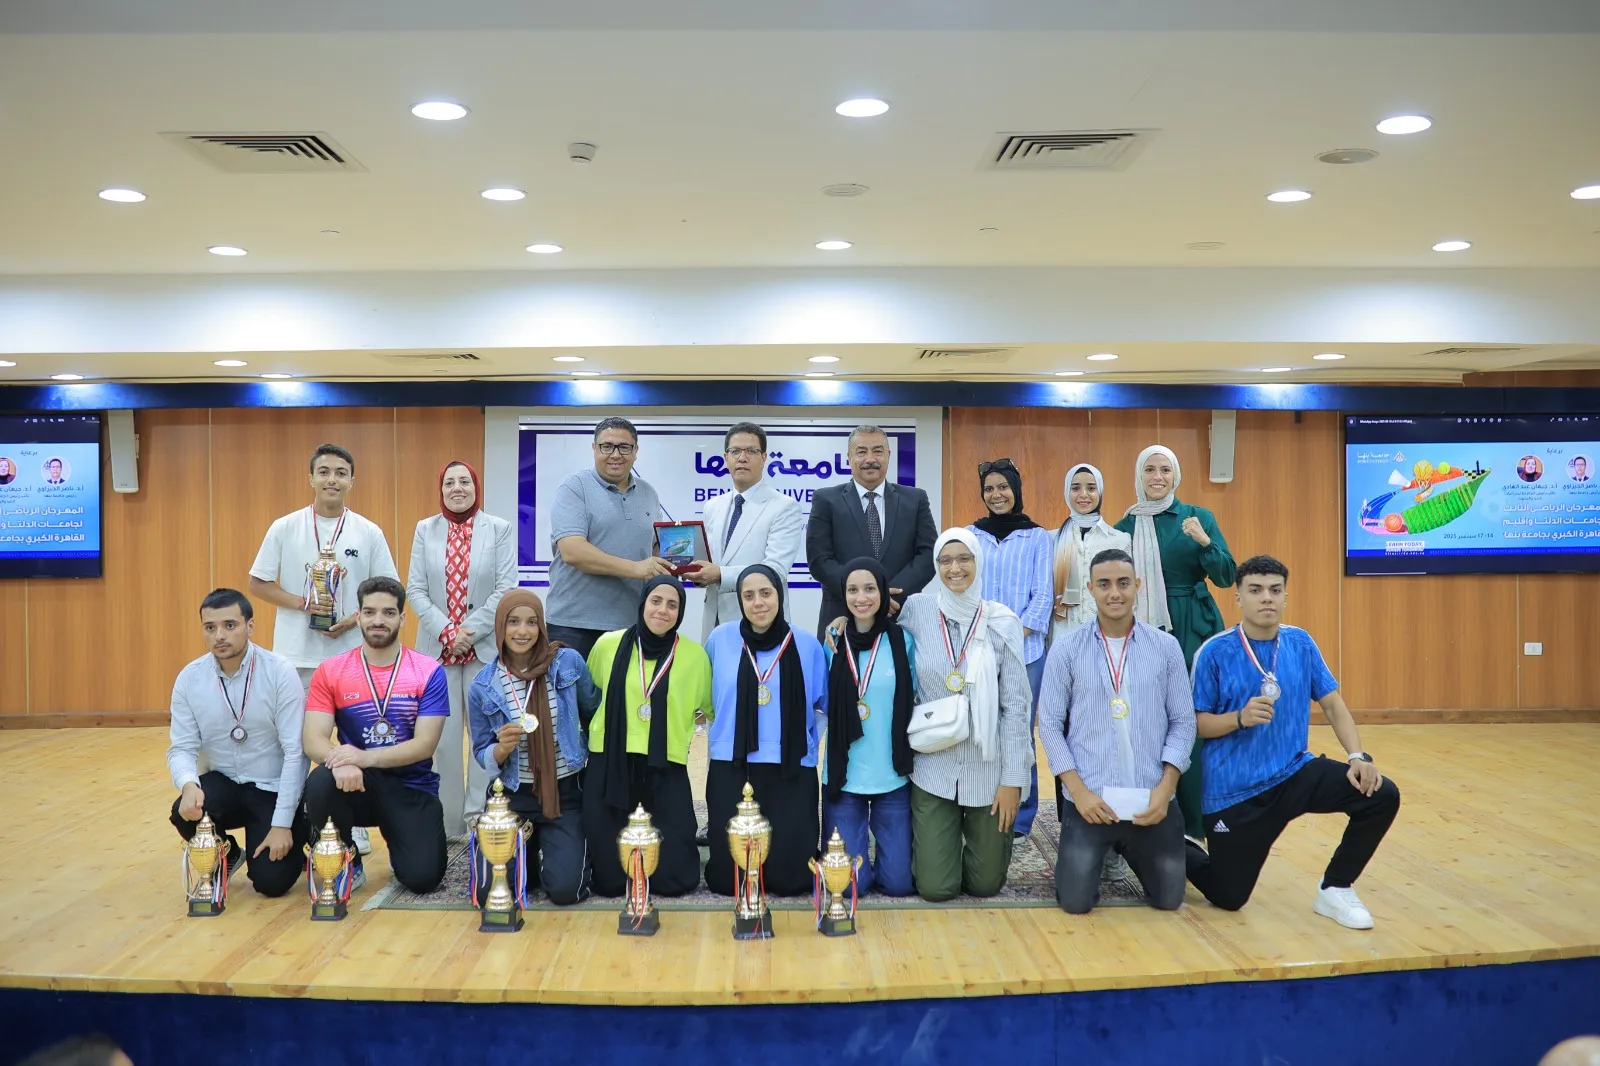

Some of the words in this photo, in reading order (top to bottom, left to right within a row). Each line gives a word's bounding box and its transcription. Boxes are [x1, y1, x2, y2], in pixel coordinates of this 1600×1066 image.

[695, 452, 730, 477] ها
[767, 451, 852, 479] امعة
[694, 488, 731, 502] BEN
[3, 506, 40, 517] الرياضي
[41, 506, 84, 516] المهرجان
[1503, 503, 1529, 512] الثالث
[1530, 504, 1565, 514] الرياضي
[1566, 504, 1600, 513] مهرجان
[7, 520, 37, 528] الدلتا
[37, 520, 83, 530] لجامعات
[1534, 517, 1562, 525] الدلتا
[0, 534, 24, 544] بجامع
[54, 533, 85, 543] القاهرة
[1503, 530, 1520, 540] بنها
[1521, 530, 1550, 540] بجامعة
